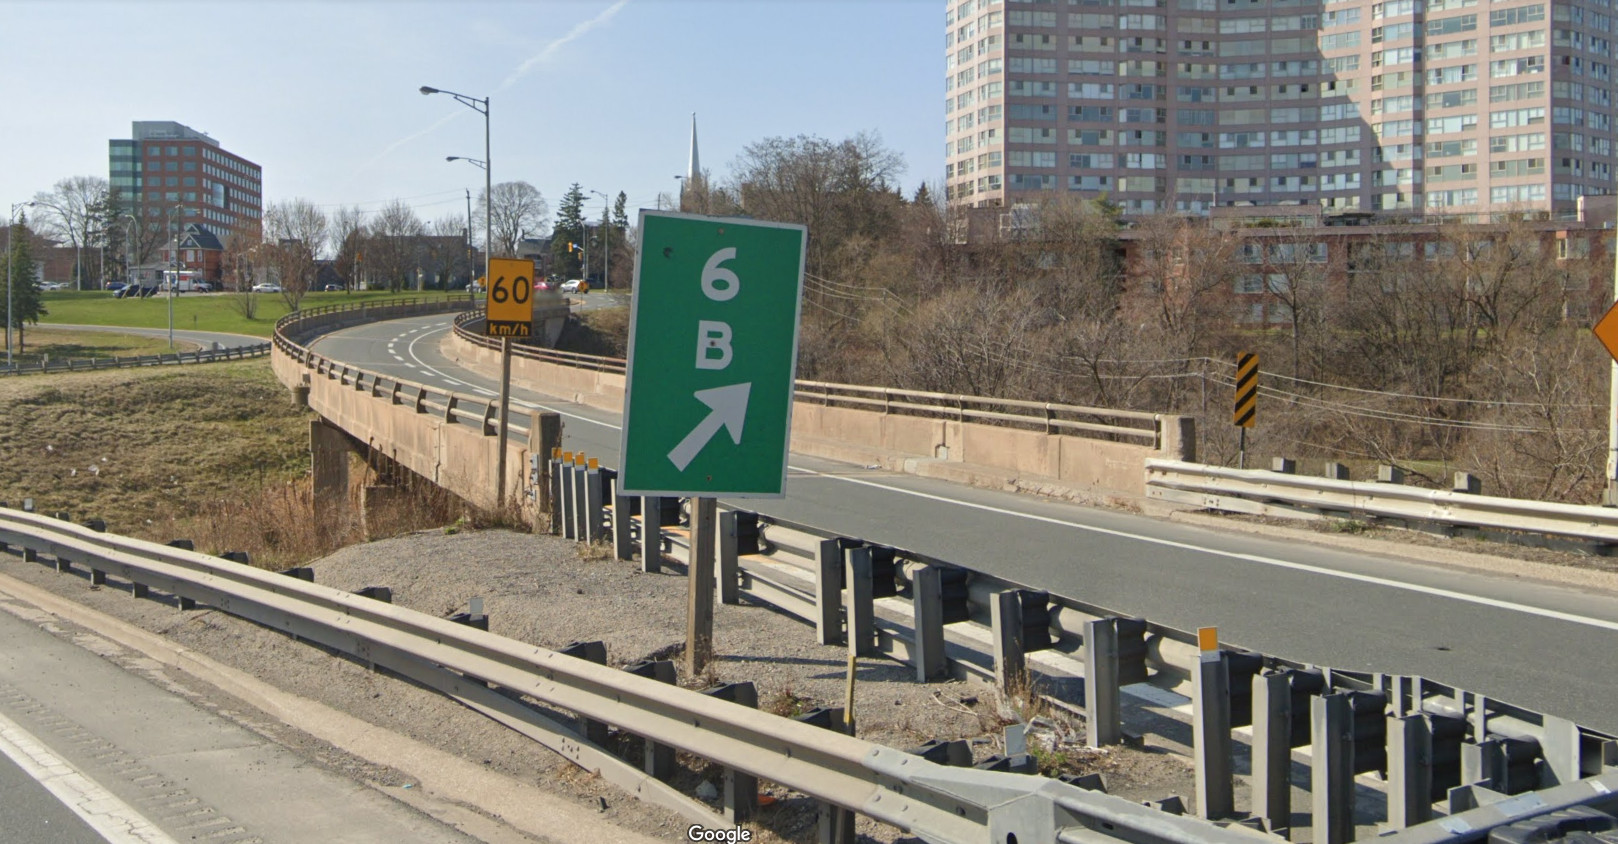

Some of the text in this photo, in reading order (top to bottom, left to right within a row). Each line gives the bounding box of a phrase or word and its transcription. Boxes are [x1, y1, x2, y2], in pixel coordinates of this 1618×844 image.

[492, 276, 530, 304] 60
[701, 247, 740, 302] 6
[489, 322, 529, 336] km/h
[696, 320, 733, 370] B
